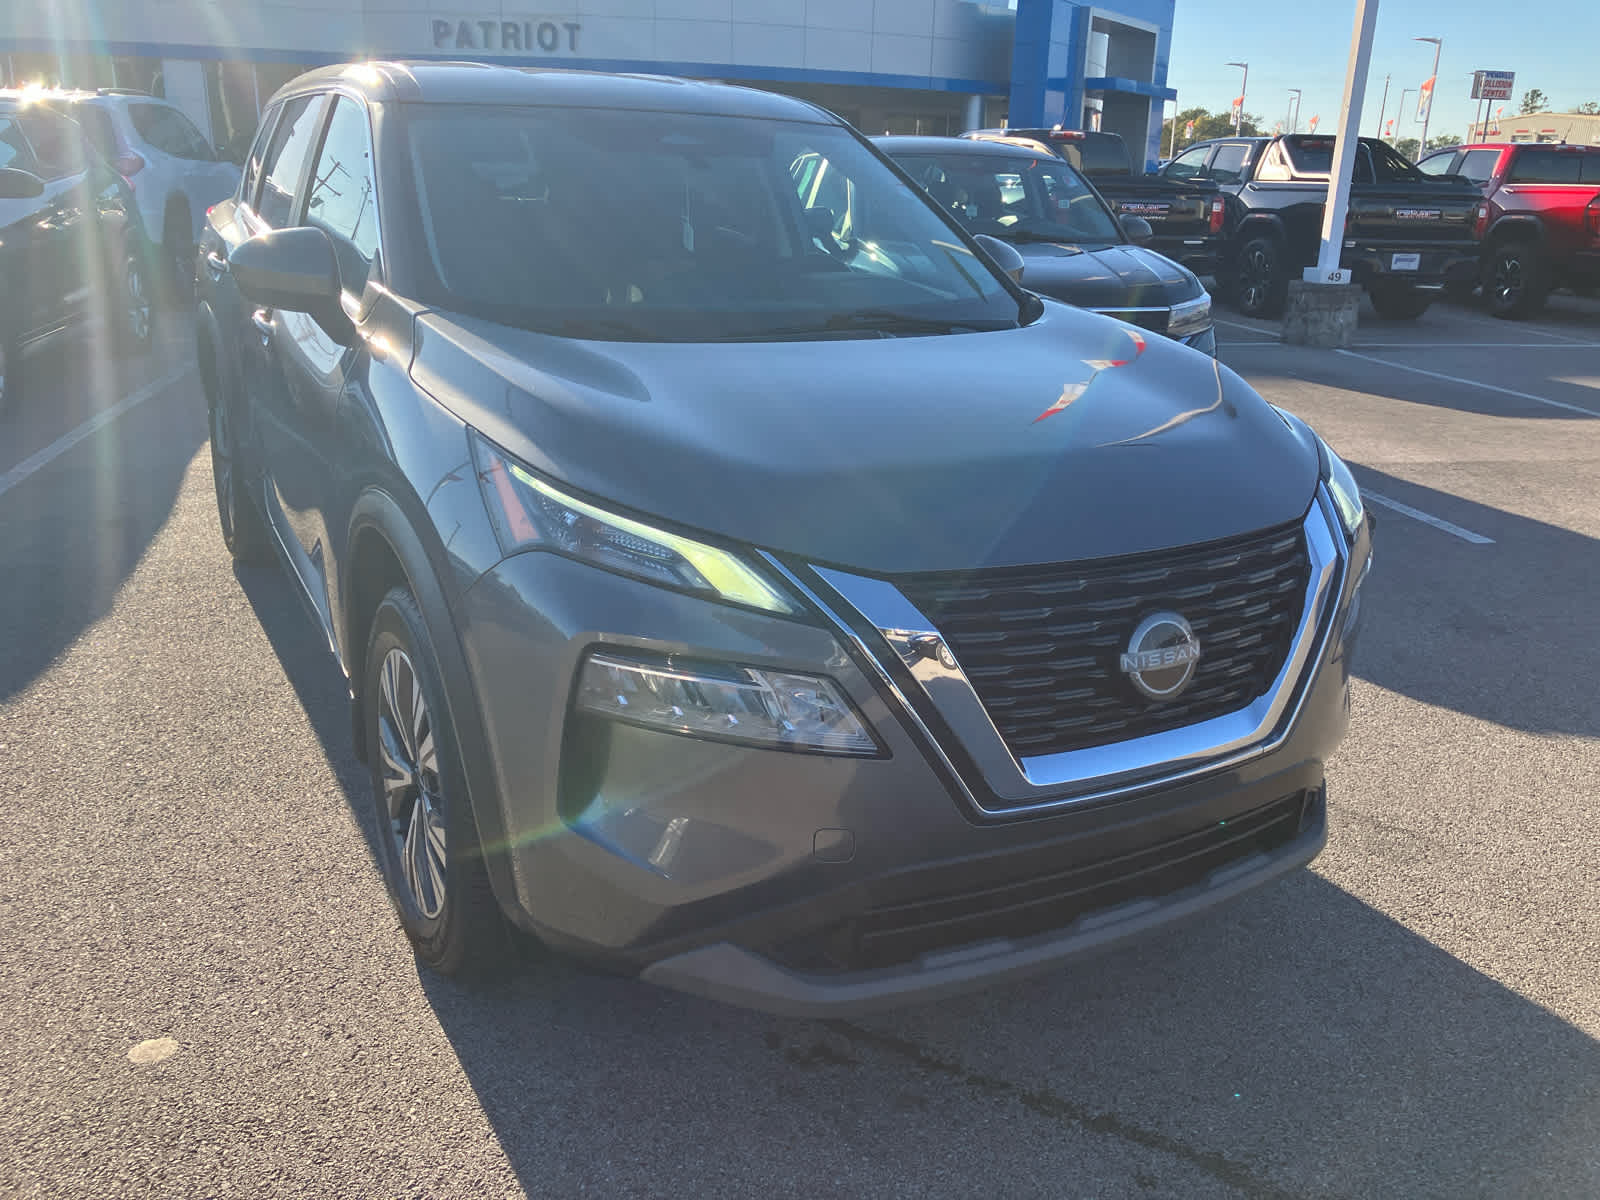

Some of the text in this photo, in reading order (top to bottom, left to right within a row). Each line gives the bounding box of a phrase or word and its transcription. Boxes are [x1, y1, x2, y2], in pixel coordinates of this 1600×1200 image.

[432, 20, 581, 51] PATRIOT
[1327, 272, 1342, 281] 49
[1121, 643, 1201, 671] NISSAN
